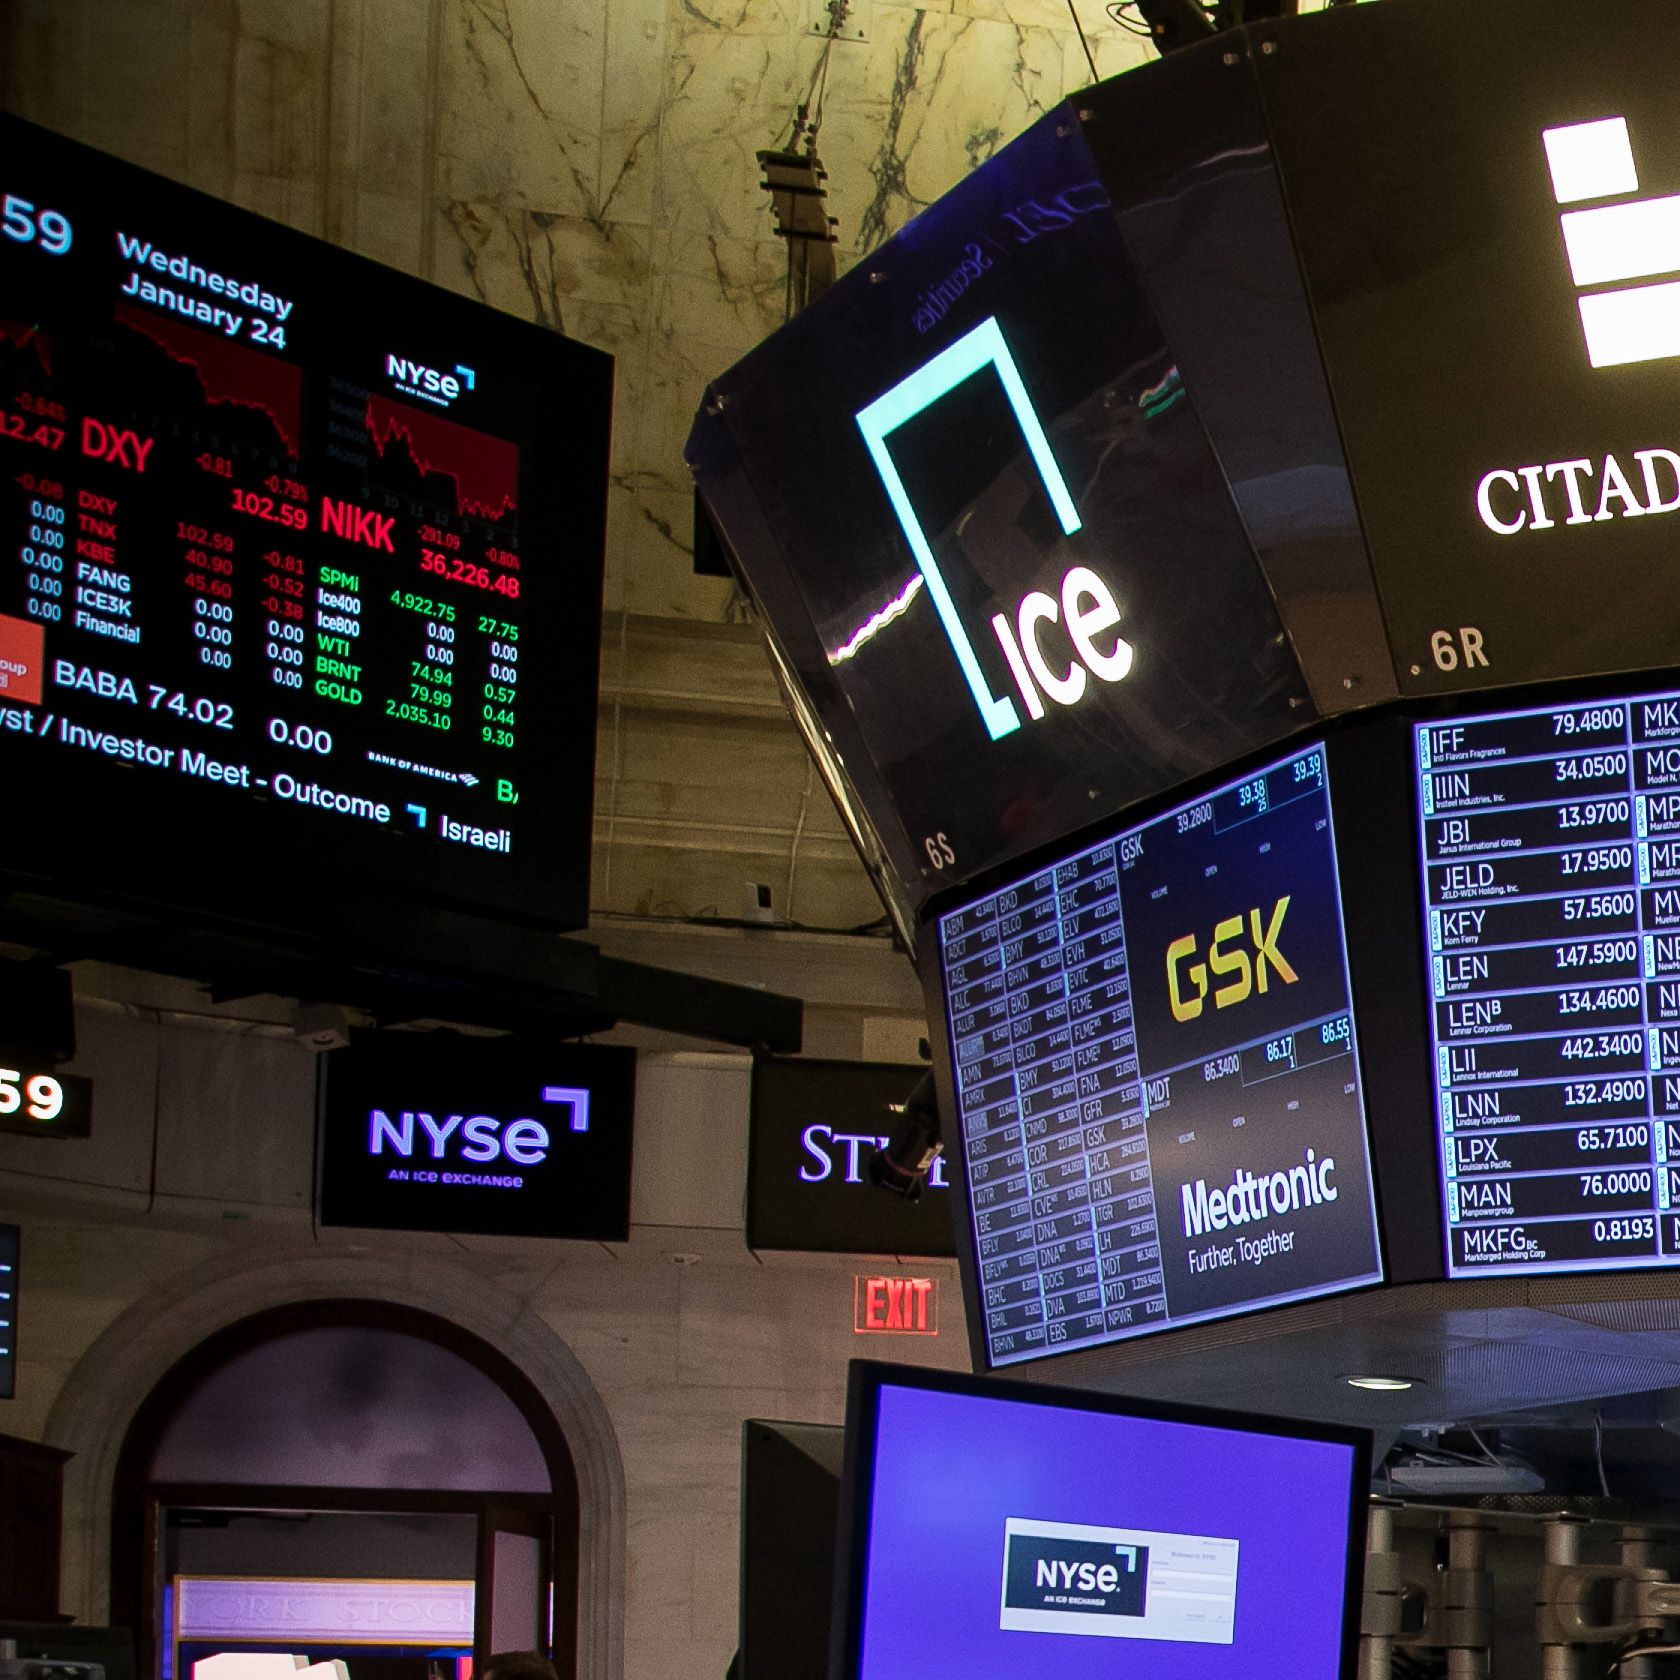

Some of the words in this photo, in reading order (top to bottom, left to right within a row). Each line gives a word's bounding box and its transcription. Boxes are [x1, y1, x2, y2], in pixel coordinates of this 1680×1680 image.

[1, 194, 72, 255] 59
[116, 231, 293, 320] Wednesday
[121, 273, 243, 335] January
[250, 318, 286, 349] 24
[81, 416, 153, 472] DXY
[196, 453, 233, 479] -0.81
[232, 489, 307, 530] 102.59
[321, 495, 396, 553] NIKK
[77, 562, 131, 592] FANG
[420, 549, 519, 598] 36,226.48
[76, 586, 132, 617] ICE3K
[390, 590, 456, 622] 4,922.75
[478, 616, 519, 641] 27.75
[75, 610, 141, 644] Financial
[1431, 627, 1490, 671] 6R
[316, 656, 362, 682] BRNT
[410, 683, 452, 708] 79.99
[317, 633, 350, 656] WTI
[411, 661, 453, 687] 74.94
[54, 659, 138, 705] BABA
[146, 684, 234, 730] 74.02
[268, 718, 332, 755] 0.00
[315, 679, 363, 705] GOLD
[385, 699, 451, 731] 2,035.10
[1432, 727, 1465, 754] IFF
[1552, 707, 1624, 735] 79.4800
[58, 717, 175, 768] Investor
[179, 748, 250, 789] Meet
[272, 773, 391, 824] Outcome
[439, 814, 511, 853] Israeli
[924, 832, 955, 873] 6S
[1443, 909, 1486, 937] KFY
[1564, 893, 1635, 920] 57.5600
[1166, 895, 1299, 1022] GSK
[1148, 1077, 1171, 1103] MDT
[1204, 1054, 1240, 1082] 86.3400
[388, 1169, 409, 1181] AN
[1181, 1148, 1337, 1238] Medtronic
[1188, 1237, 1236, 1275] Further,
[1237, 1231, 1295, 1268] Together
[866, 1279, 932, 1330] EXIT
